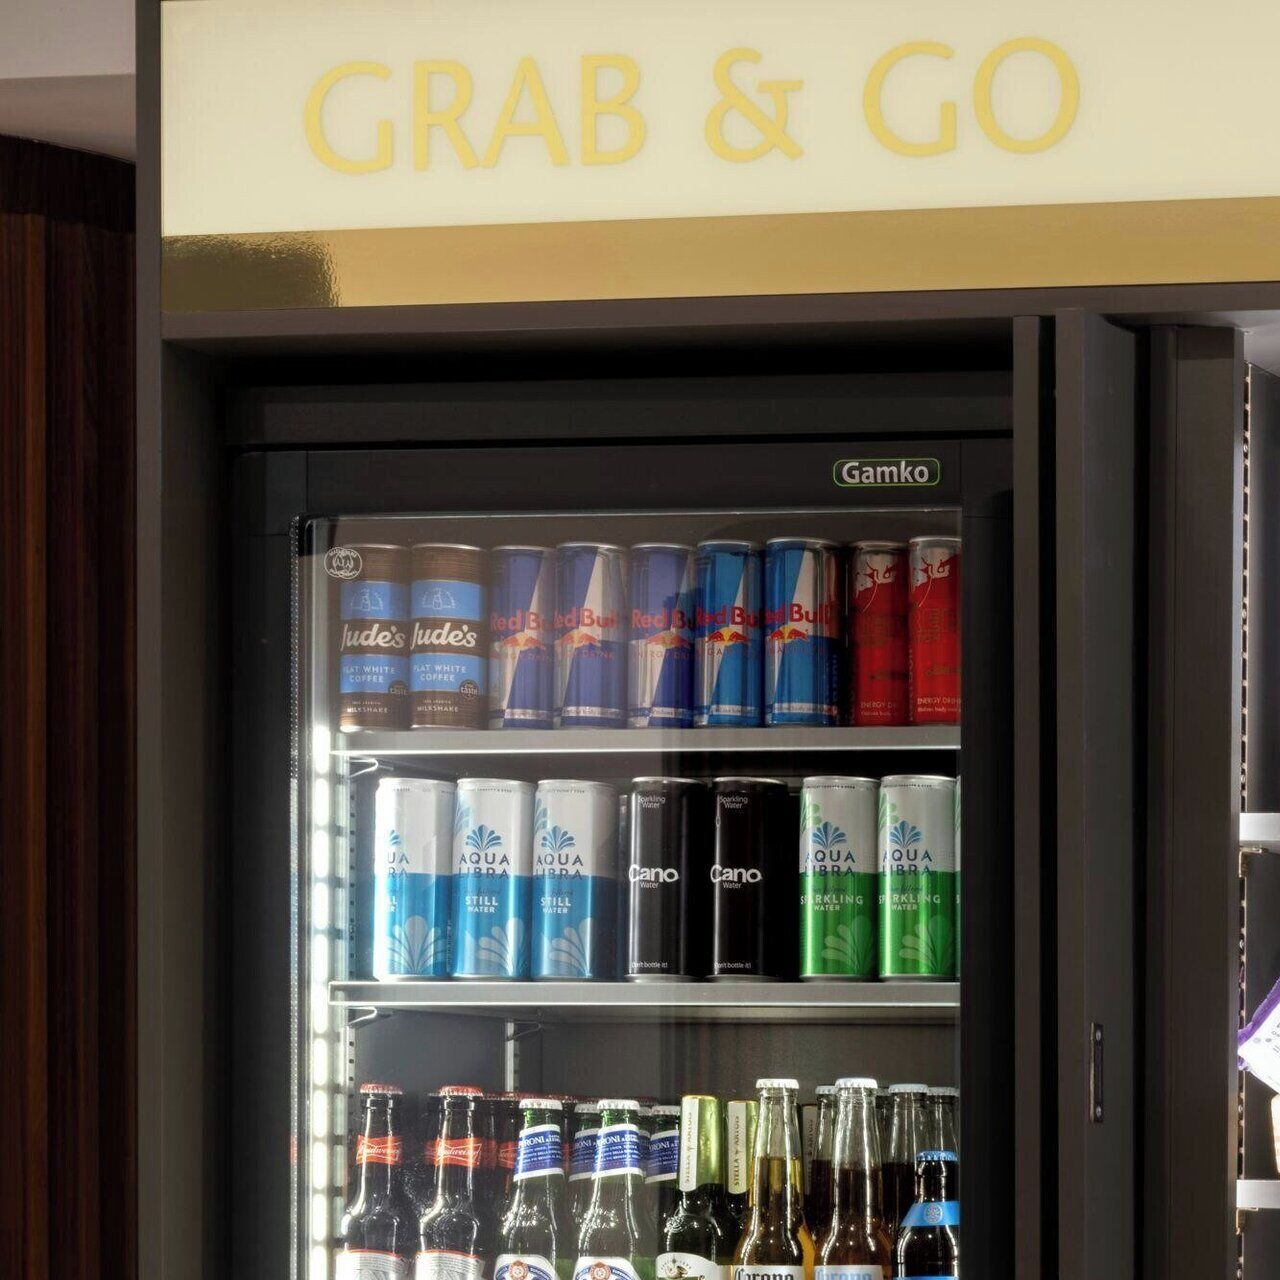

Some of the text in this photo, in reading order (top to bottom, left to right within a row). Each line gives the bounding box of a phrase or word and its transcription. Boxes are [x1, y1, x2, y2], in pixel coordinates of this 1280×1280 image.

[304, 36, 1081, 175] GRAB & GO
[842, 461, 929, 483] Gamko
[341, 624, 405, 651] Jude's
[411, 623, 477, 650] Jude's
[363, 665, 396, 674] WHITE
[437, 664, 466, 673] WHITE
[350, 675, 384, 683] COFFEE
[420, 673, 455, 682] COFFEE
[459, 852, 510, 865] AQUA
[536, 853, 583, 866] AQUA
[459, 867, 509, 879] LIBRA
[536, 868, 583, 880] LIBRA
[629, 864, 679, 883] Cano
[710, 864, 763, 883] Cano
[465, 896, 498, 906] STILL
[541, 897, 571, 906] STILL
